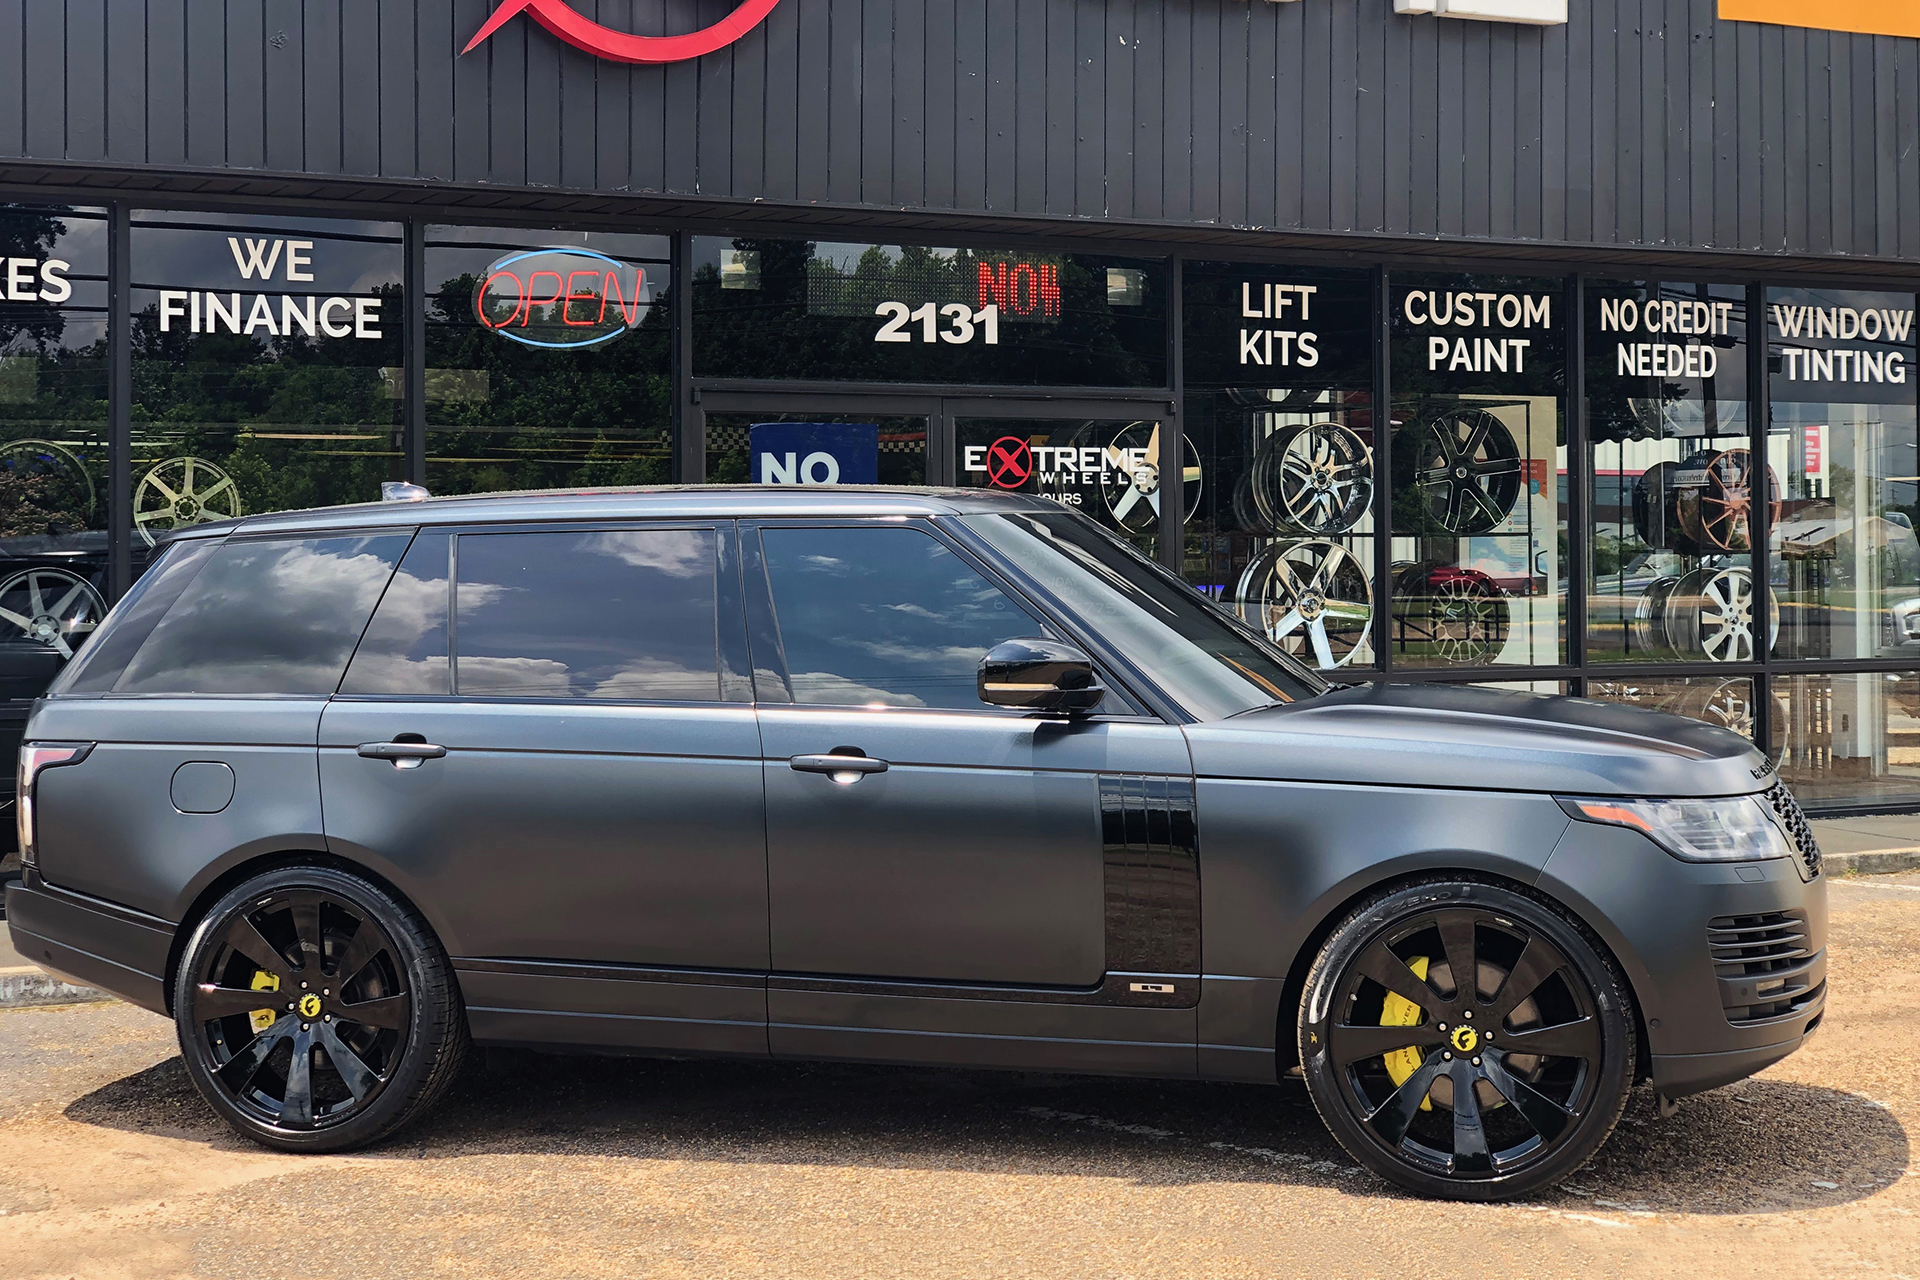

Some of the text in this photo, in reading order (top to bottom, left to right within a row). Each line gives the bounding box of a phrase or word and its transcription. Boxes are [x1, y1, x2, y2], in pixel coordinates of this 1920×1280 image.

[228, 238, 313, 281] WE
[160, 290, 382, 338] FINANCE
[478, 269, 642, 328] OPEN
[1242, 282, 1317, 320] LIFT
[1404, 290, 1550, 329] CUSTOM
[1601, 298, 1733, 335] NO CREDIT
[874, 301, 998, 345] 2131
[1773, 305, 1914, 341] WINDOW
[1240, 329, 1318, 367] KITS
[1429, 336, 1530, 373] PAINT
[1618, 343, 1717, 378] NEEDED
[1783, 348, 1906, 383] TINTING
[761, 451, 840, 483] NO
[964, 438, 1150, 483] EXTREME
[1040, 472, 1147, 484] WHEELS
